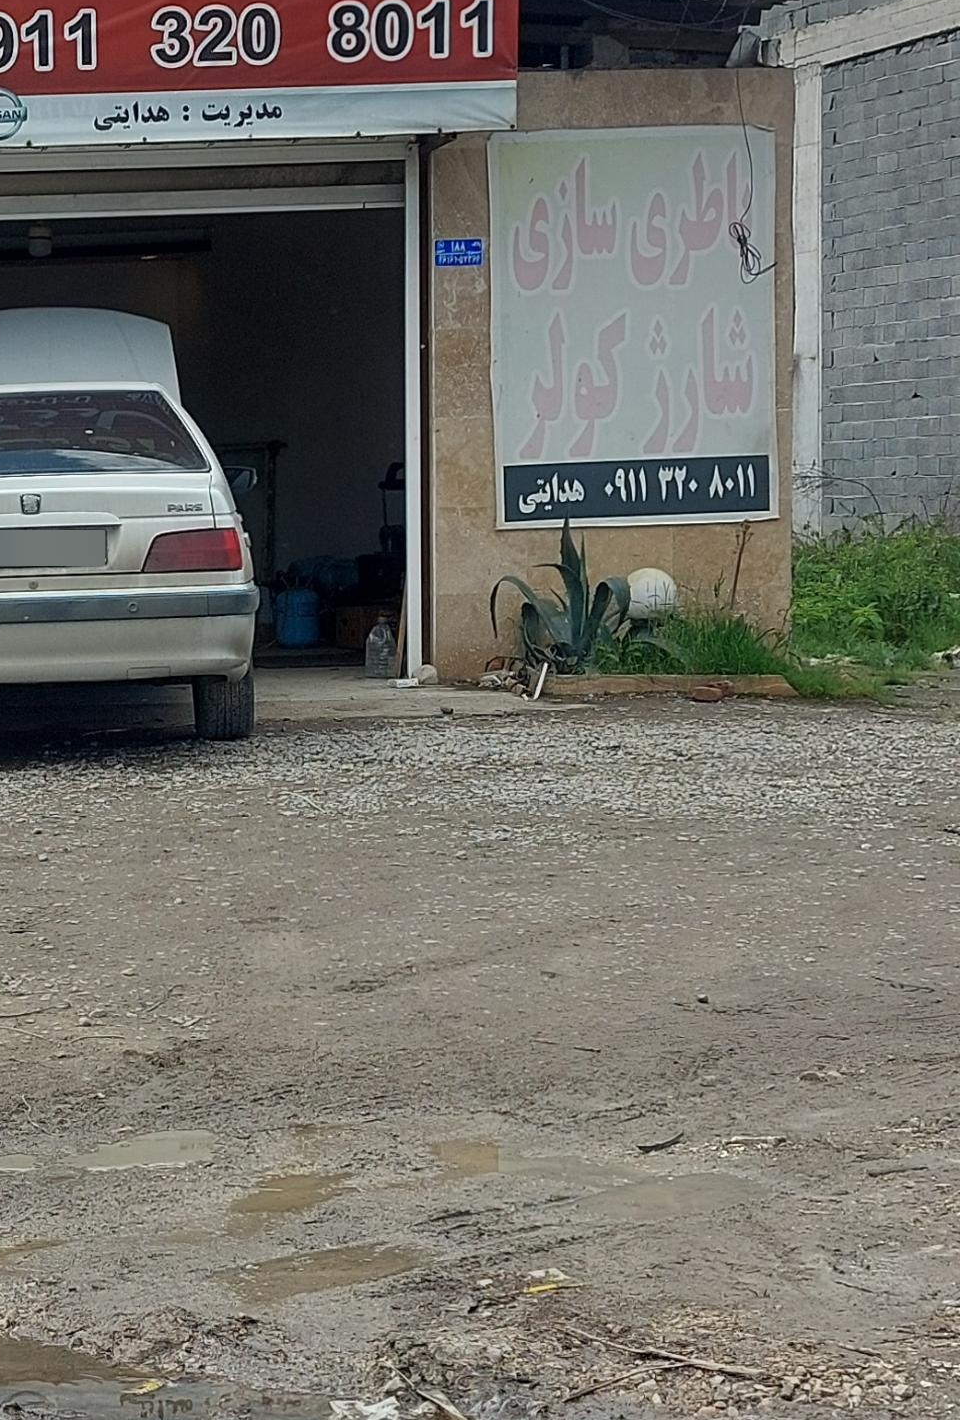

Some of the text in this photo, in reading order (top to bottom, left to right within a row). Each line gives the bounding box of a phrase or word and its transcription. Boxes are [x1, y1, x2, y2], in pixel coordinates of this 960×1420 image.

[150, 2, 282, 69] 320
[93, 100, 171, 131] هدایتی
[201, 101, 283, 128] مدیریت
[512, 155, 618, 292] سازی
[519, 306, 754, 460] شارژ کولر
[167, 502, 203, 513] PARS
[518, 463, 756, 515] ۰۹۱۱ ۳۲۰ ۸۰۱۱ هدایتی
